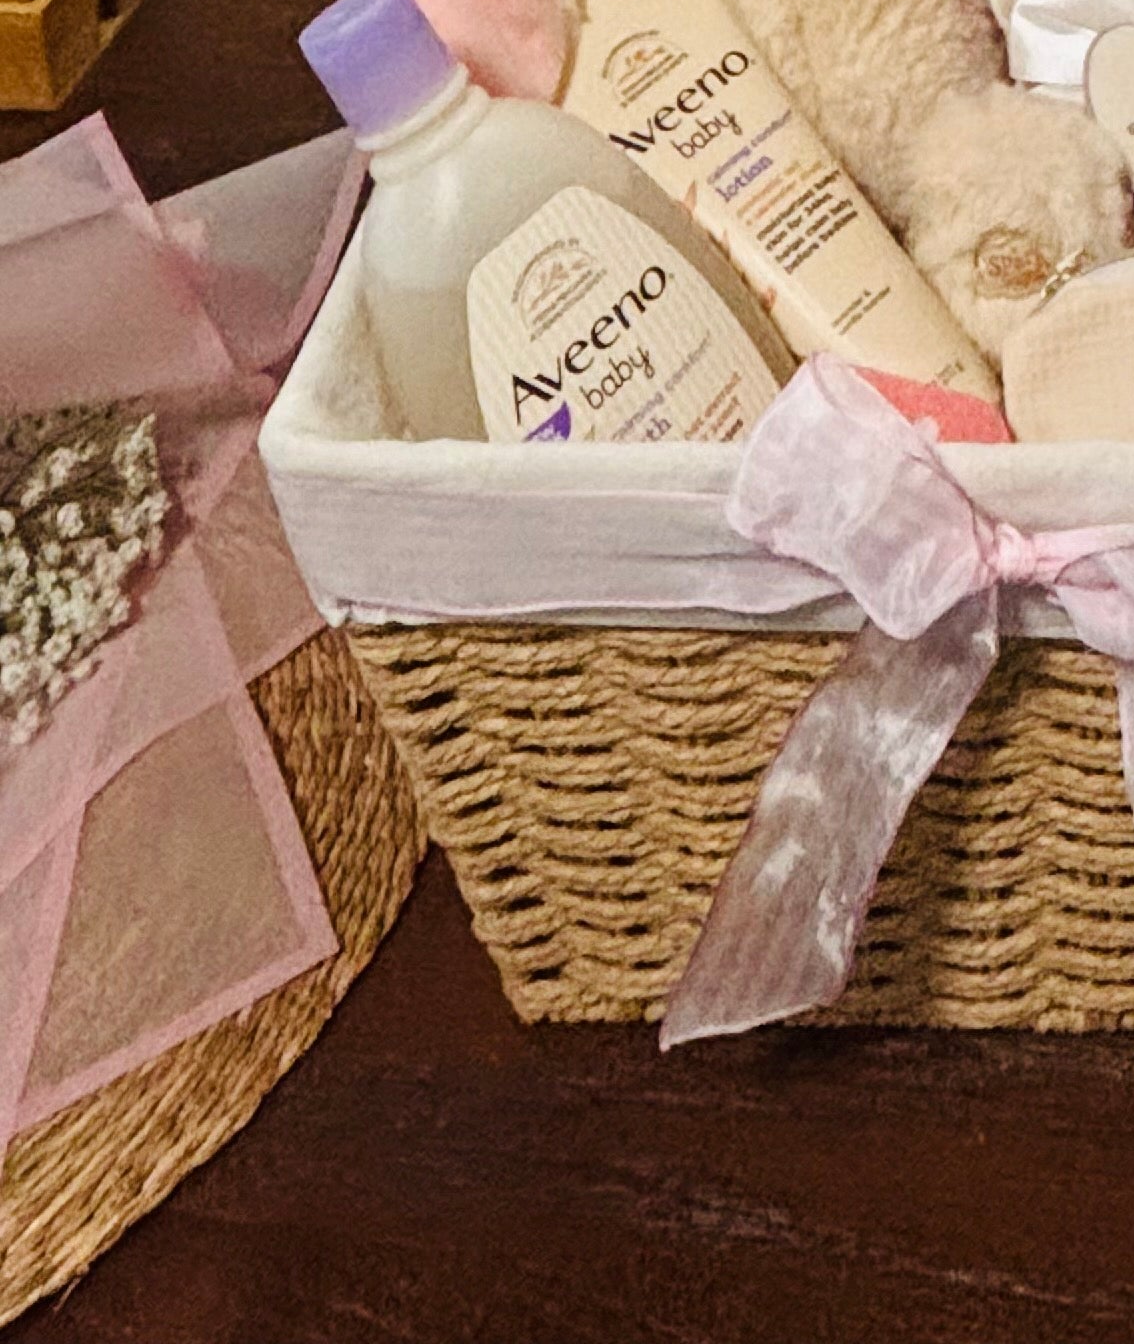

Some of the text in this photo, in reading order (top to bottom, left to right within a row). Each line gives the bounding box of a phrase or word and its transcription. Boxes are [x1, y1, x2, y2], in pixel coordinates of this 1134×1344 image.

[670, 109, 742, 159] baby
[715, 156, 773, 203] lotion
[512, 265, 667, 425] Aveeno
[579, 344, 656, 410] baby
